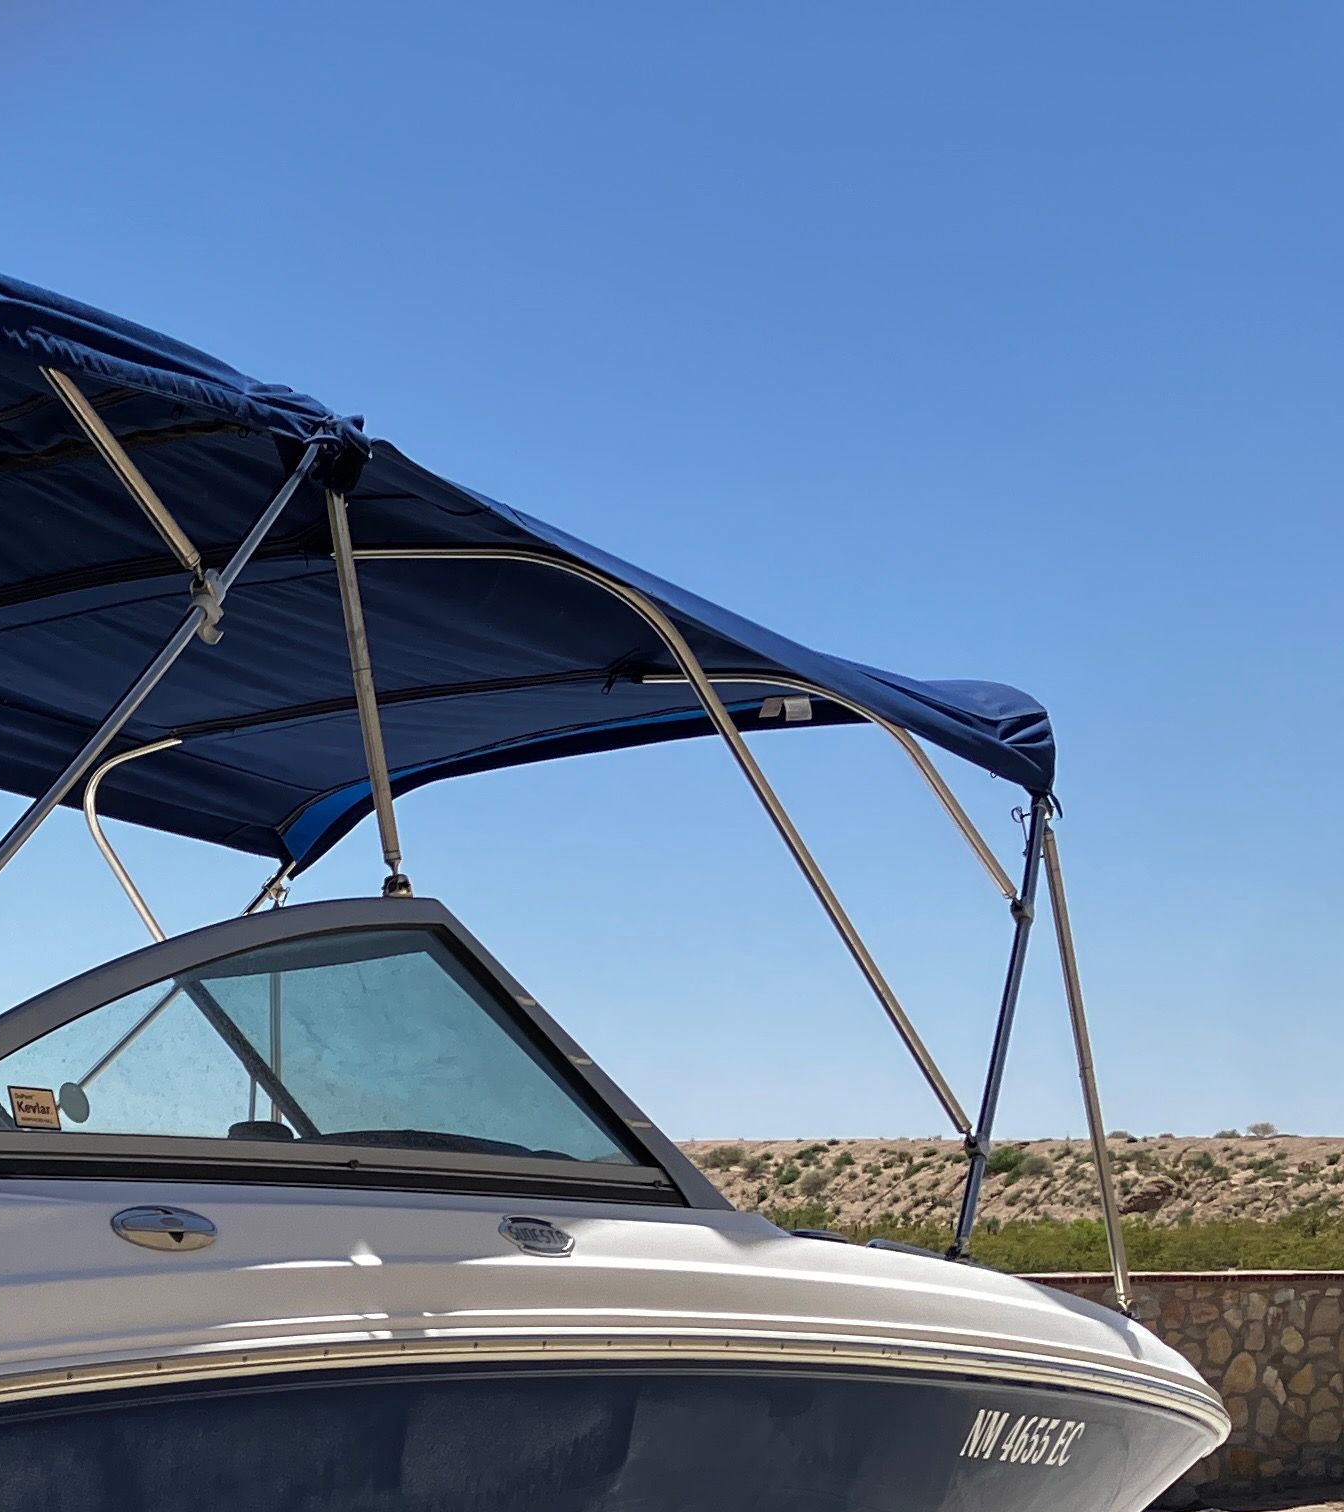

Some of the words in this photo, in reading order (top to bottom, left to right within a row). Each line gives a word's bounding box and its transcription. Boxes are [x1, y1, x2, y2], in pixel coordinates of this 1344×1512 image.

[959, 1409, 1010, 1460] NM
[999, 1415, 1061, 1465] 4655
[1045, 1421, 1085, 1467] EC
